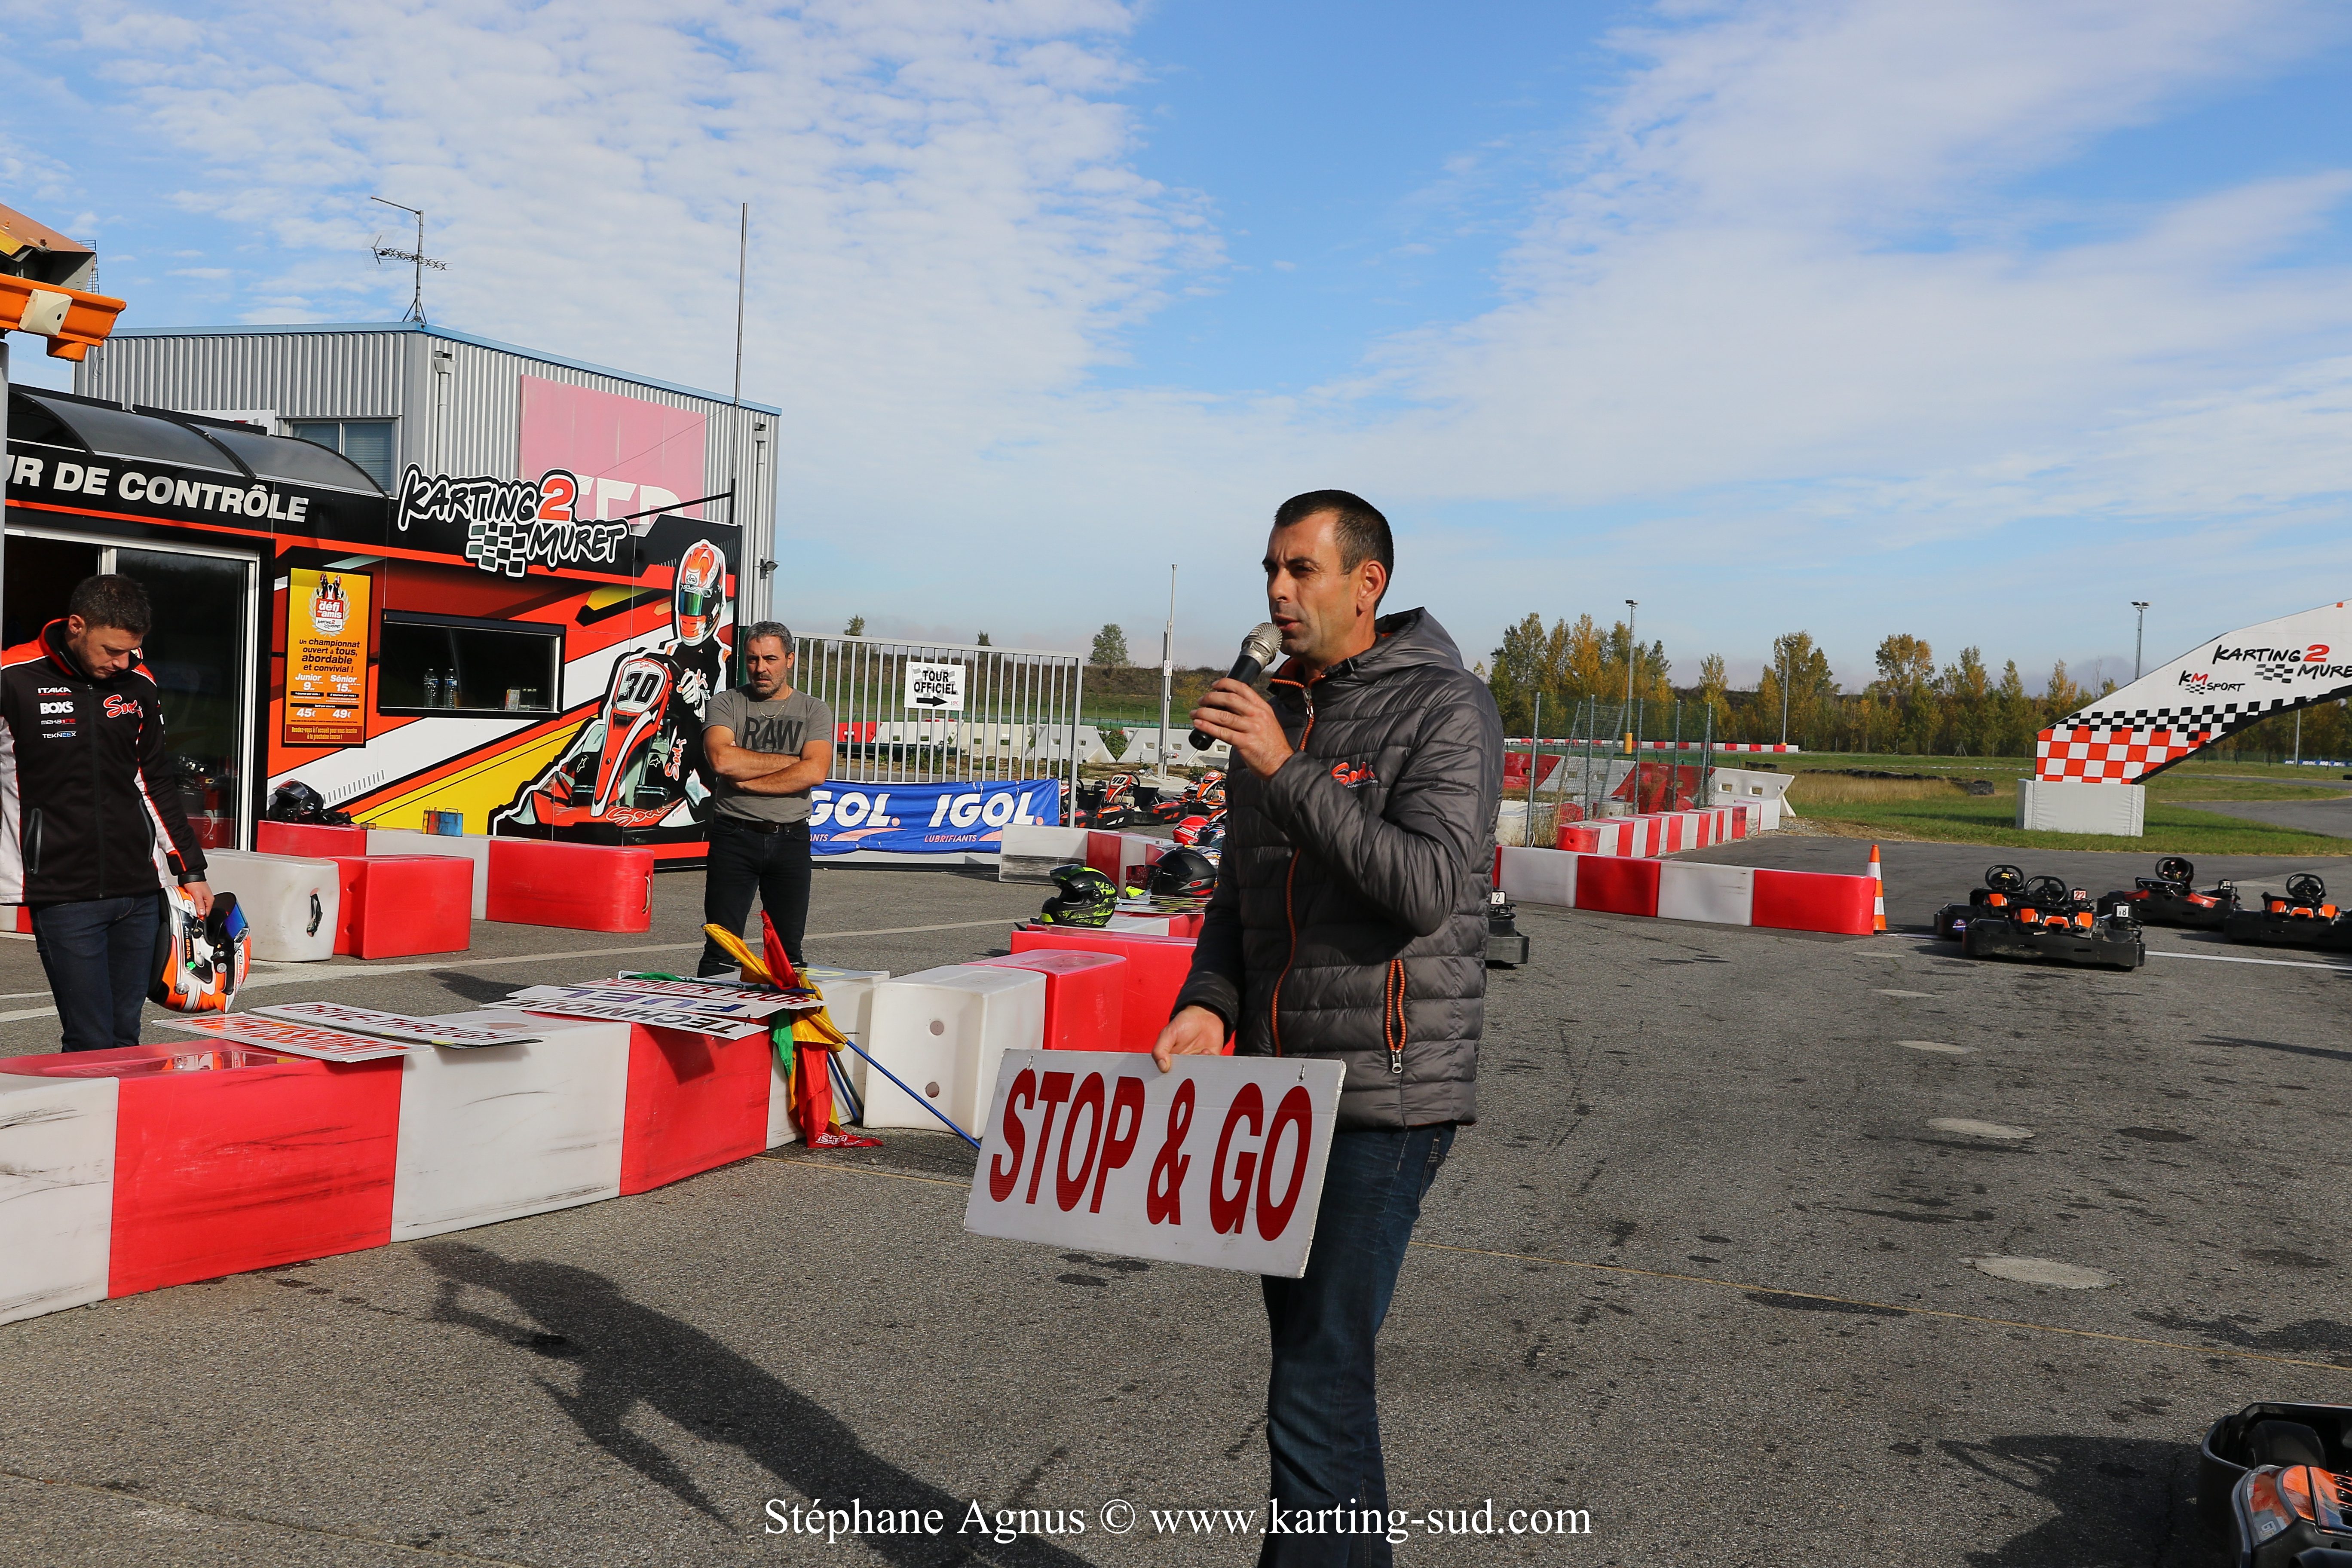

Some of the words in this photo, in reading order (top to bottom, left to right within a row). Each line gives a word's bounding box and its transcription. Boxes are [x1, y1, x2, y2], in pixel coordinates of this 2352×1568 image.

[53, 461, 110, 496] DE
[118, 472, 309, 523] CONTRÔLE
[400, 464, 536, 531] KARTING
[538, 477, 575, 522] 2
[528, 523, 628, 567] MURET
[319, 601, 340, 612] défi
[309, 638, 360, 648] championnat
[302, 654, 352, 664] abordable
[336, 647, 358, 657] tous,
[2212, 644, 2301, 665] KARTING
[2303, 644, 2330, 662] 2
[295, 673, 322, 681] Junior
[330, 674, 358, 683] Sénior
[923, 671, 949, 682] TOUR
[2178, 670, 2208, 686] KM
[616, 672, 660, 704] 30
[914, 682, 956, 695] OFFICIEL
[2207, 683, 2245, 692] SPORT
[296, 708, 316, 717] 45€
[332, 709, 352, 718] 49€
[742, 716, 803, 752] RAW
[665, 738, 687, 781] Sodi
[1331, 761, 1375, 786] Sodi
[924, 833, 977, 843] LUBRIFIANTS
[1496, 893, 1500, 903] 2
[2075, 891, 2085, 900] 22
[585, 979, 717, 994] DERNIER
[720, 989, 811, 1005] TOUR
[558, 988, 748, 1013] FUEL
[279, 1004, 518, 1041] DRIVE-THROUGH
[496, 1000, 742, 1034] TECHNIQUE
[175, 1014, 412, 1056] AVERTISSEMENT
[989, 1068, 1145, 1214] STOP
[1146, 1078, 1196, 1226] &
[1210, 1082, 1313, 1242] GO
